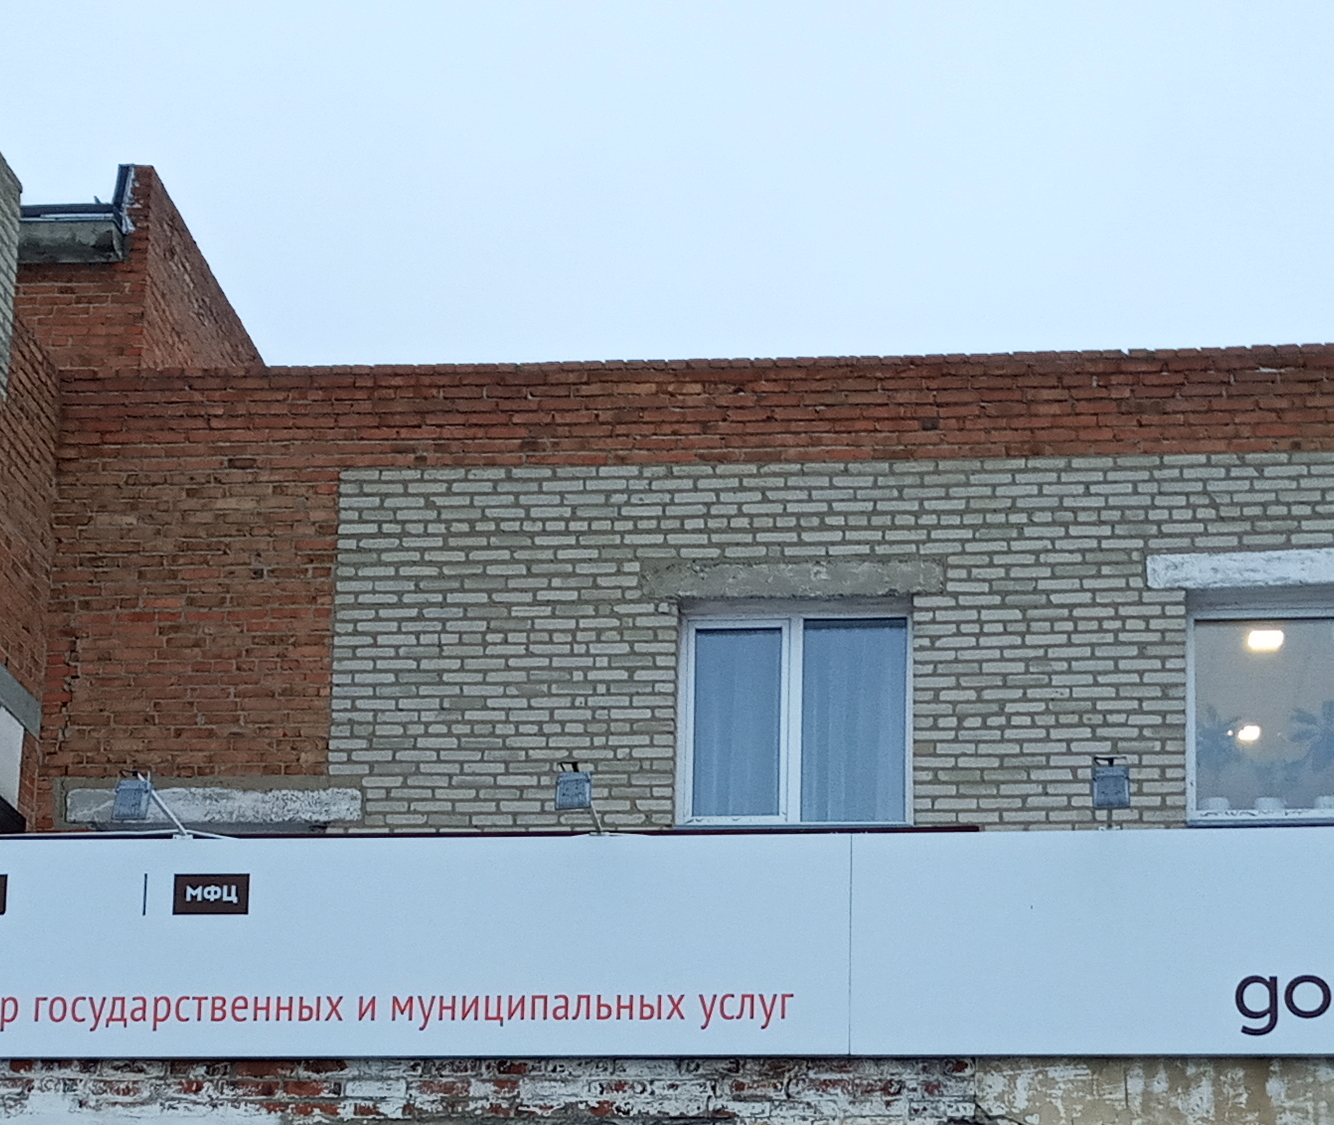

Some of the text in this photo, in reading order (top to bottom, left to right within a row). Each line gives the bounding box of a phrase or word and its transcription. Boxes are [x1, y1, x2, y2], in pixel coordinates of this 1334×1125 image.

[185, 883, 239, 905] МФЦ
[33, 995, 344, 1032] государственных
[357, 995, 378, 1022] и
[390, 994, 686, 1031] муниципальных
[698, 992, 795, 1030] услуг
